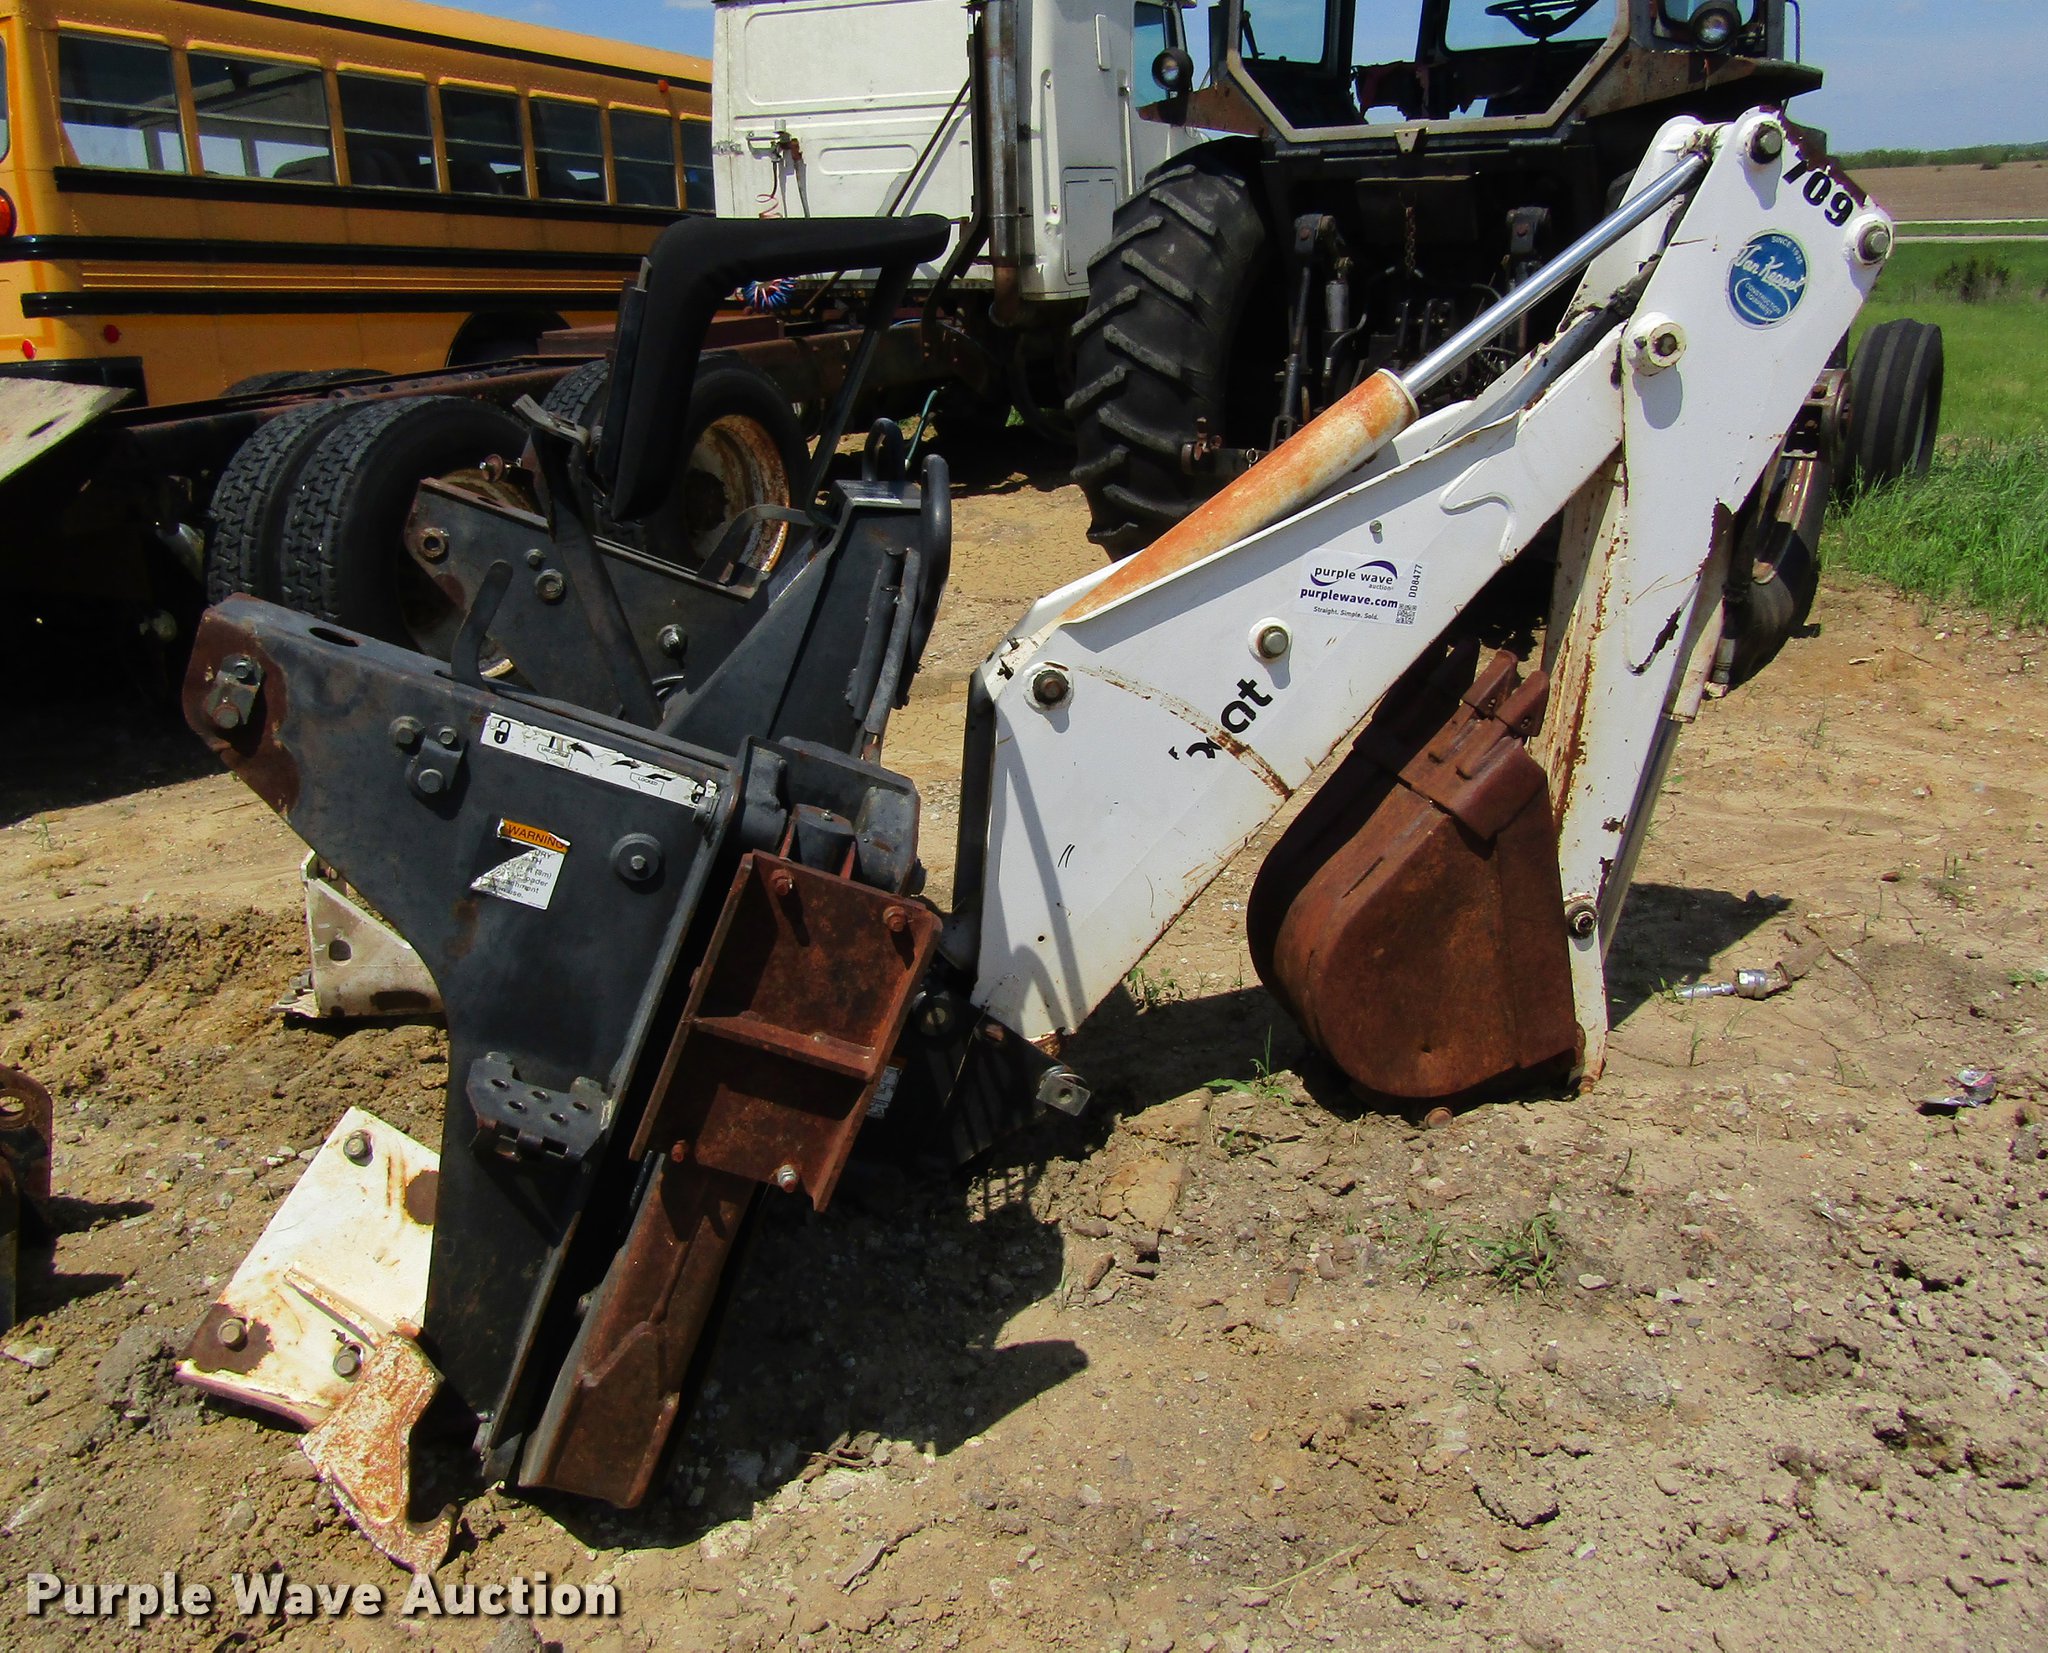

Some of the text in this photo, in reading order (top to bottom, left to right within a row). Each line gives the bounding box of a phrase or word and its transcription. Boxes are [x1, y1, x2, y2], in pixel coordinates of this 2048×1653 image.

[1770, 235, 1792, 248] SINCE
[1314, 567, 1394, 585] purple wave
[1408, 563, 1423, 598] DD8477
[1300, 588, 1398, 609] purplewave.com
[1313, 606, 1339, 616] Straight.
[1340, 610, 1363, 619] Simple.
[638, 776, 659, 786] LOCKED
[508, 824, 565, 849] WARNING
